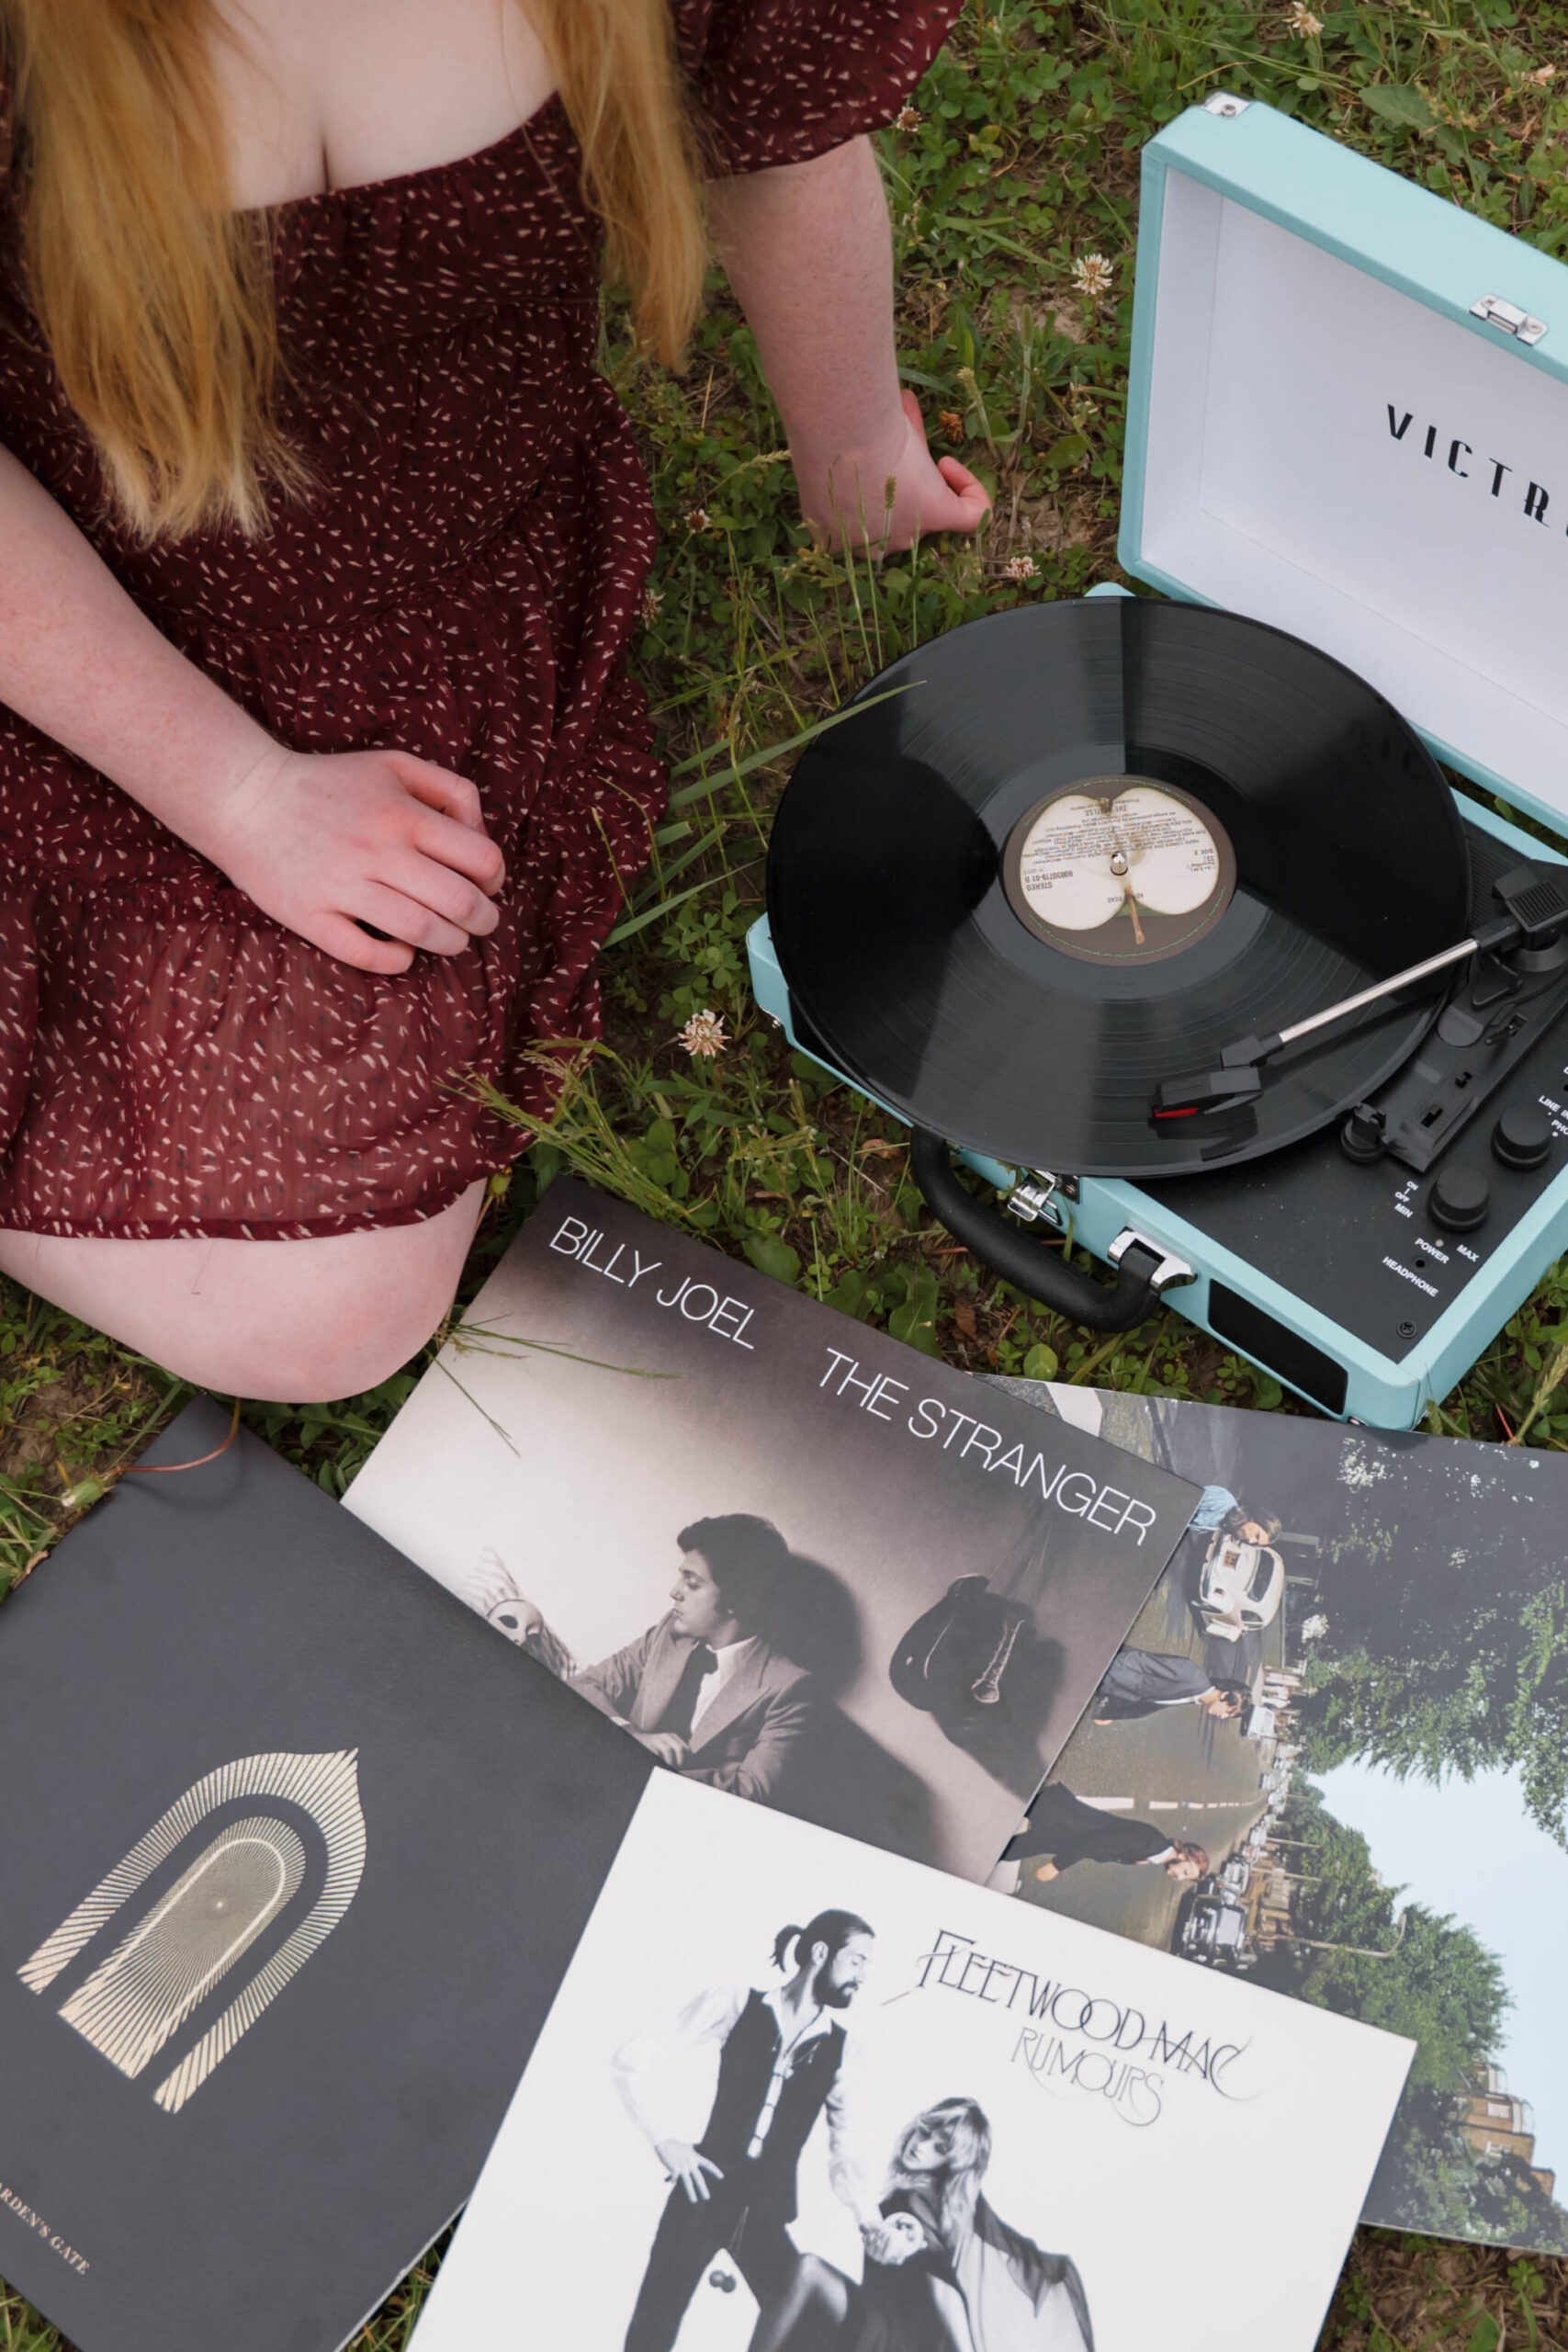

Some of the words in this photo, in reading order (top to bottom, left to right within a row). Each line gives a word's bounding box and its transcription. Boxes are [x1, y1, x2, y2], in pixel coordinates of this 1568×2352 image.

[1387, 403, 1568, 537] VICTR
[1026, 882, 1053, 891] STEREO
[1539, 1095, 1562, 1113] LINE
[1394, 1191, 1410, 1203] OFF
[1406, 1181, 1419, 1191] ON
[1394, 1203, 1414, 1218] MIN
[1415, 1238, 1450, 1264] POWER
[1456, 1244, 1480, 1262] MAX
[549, 1216, 662, 1287] BILLY
[656, 1276, 754, 1350] JOEL
[1382, 1256, 1439, 1297] HEADPHONE
[819, 1347, 909, 1421] THE
[908, 1397, 1157, 1547] STRANGER
[881, 1928, 1145, 2050] FLEETWOOD
[1146, 2020, 1262, 2101] MAC
[1010, 2027, 1164, 2127] RUMOURS
[0, 2182, 51, 2238] RDEN'S
[50, 2235, 90, 2275] GATE
